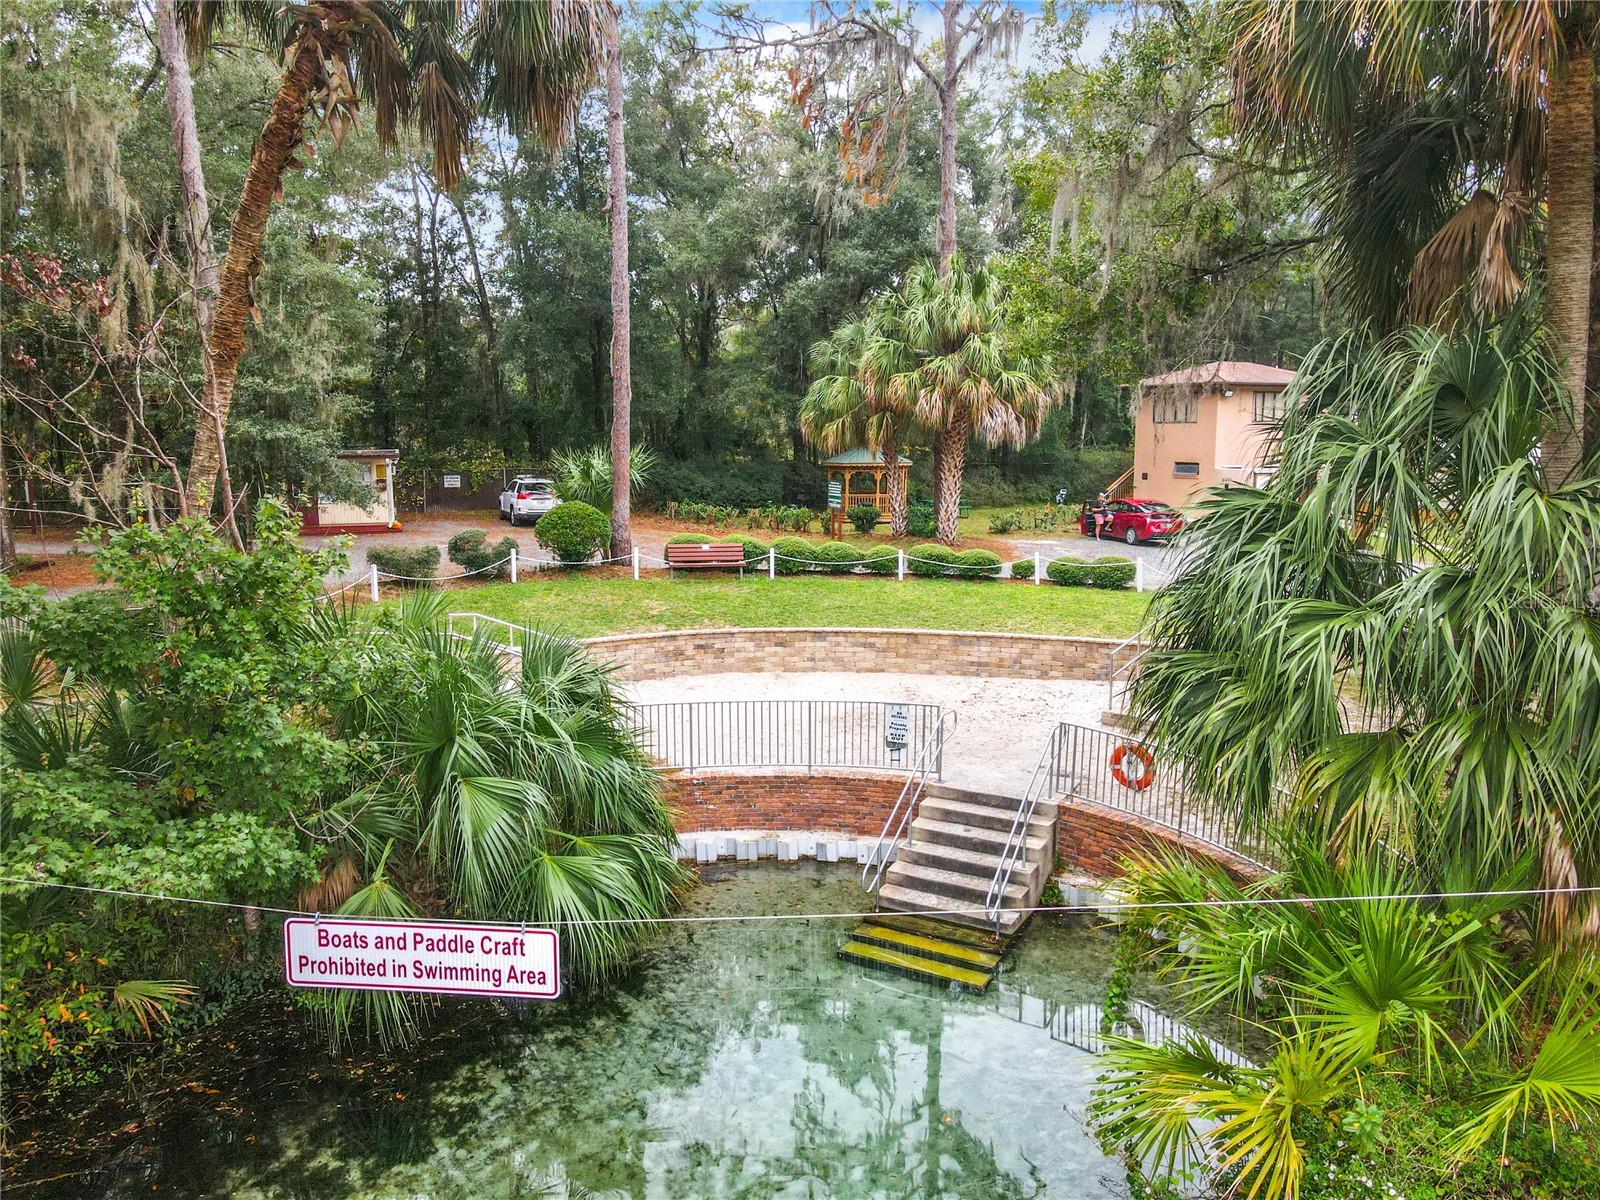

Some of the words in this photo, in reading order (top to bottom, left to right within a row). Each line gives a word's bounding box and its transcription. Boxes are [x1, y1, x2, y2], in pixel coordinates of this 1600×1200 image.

[317, 928, 369, 949] Boats
[374, 932, 407, 951] and
[413, 932, 475, 954] Paddle
[480, 935, 526, 957] Craft
[298, 955, 387, 977] Prohibited
[392, 959, 407, 978] in
[412, 960, 502, 988] Swimming
[506, 964, 547, 986] Area
